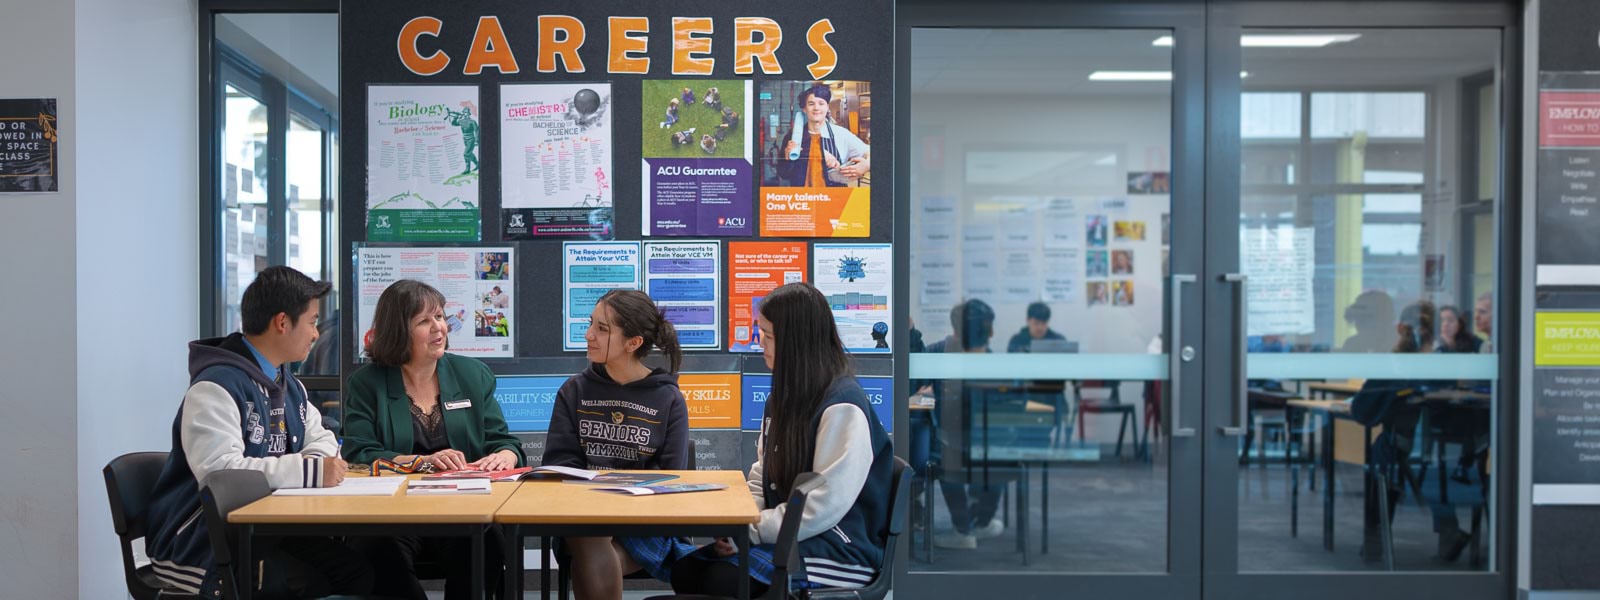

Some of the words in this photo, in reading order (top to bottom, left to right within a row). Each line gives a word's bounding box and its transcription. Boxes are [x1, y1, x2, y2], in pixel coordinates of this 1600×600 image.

[397, 15, 838, 80] CAREERS
[388, 102, 446, 119] Biology
[508, 103, 568, 118] CHEMISTRY
[11, 122, 26, 130] OR
[31, 132, 42, 140] IN
[547, 127, 580, 136] SCIENCE
[7, 142, 39, 150] SPACE
[657, 166, 680, 176] ACU
[682, 166, 737, 176] Guarantee
[766, 193, 792, 202] Many
[794, 192, 832, 201] talents.
[766, 202, 786, 210] One
[788, 202, 811, 210] VCE.
[724, 218, 746, 226] ACU
[692, 390, 730, 401] SKILLS
[621, 400, 658, 416] SECONDARY
[580, 420, 650, 446] SENIORS
[586, 442, 640, 461] MMXXIII
